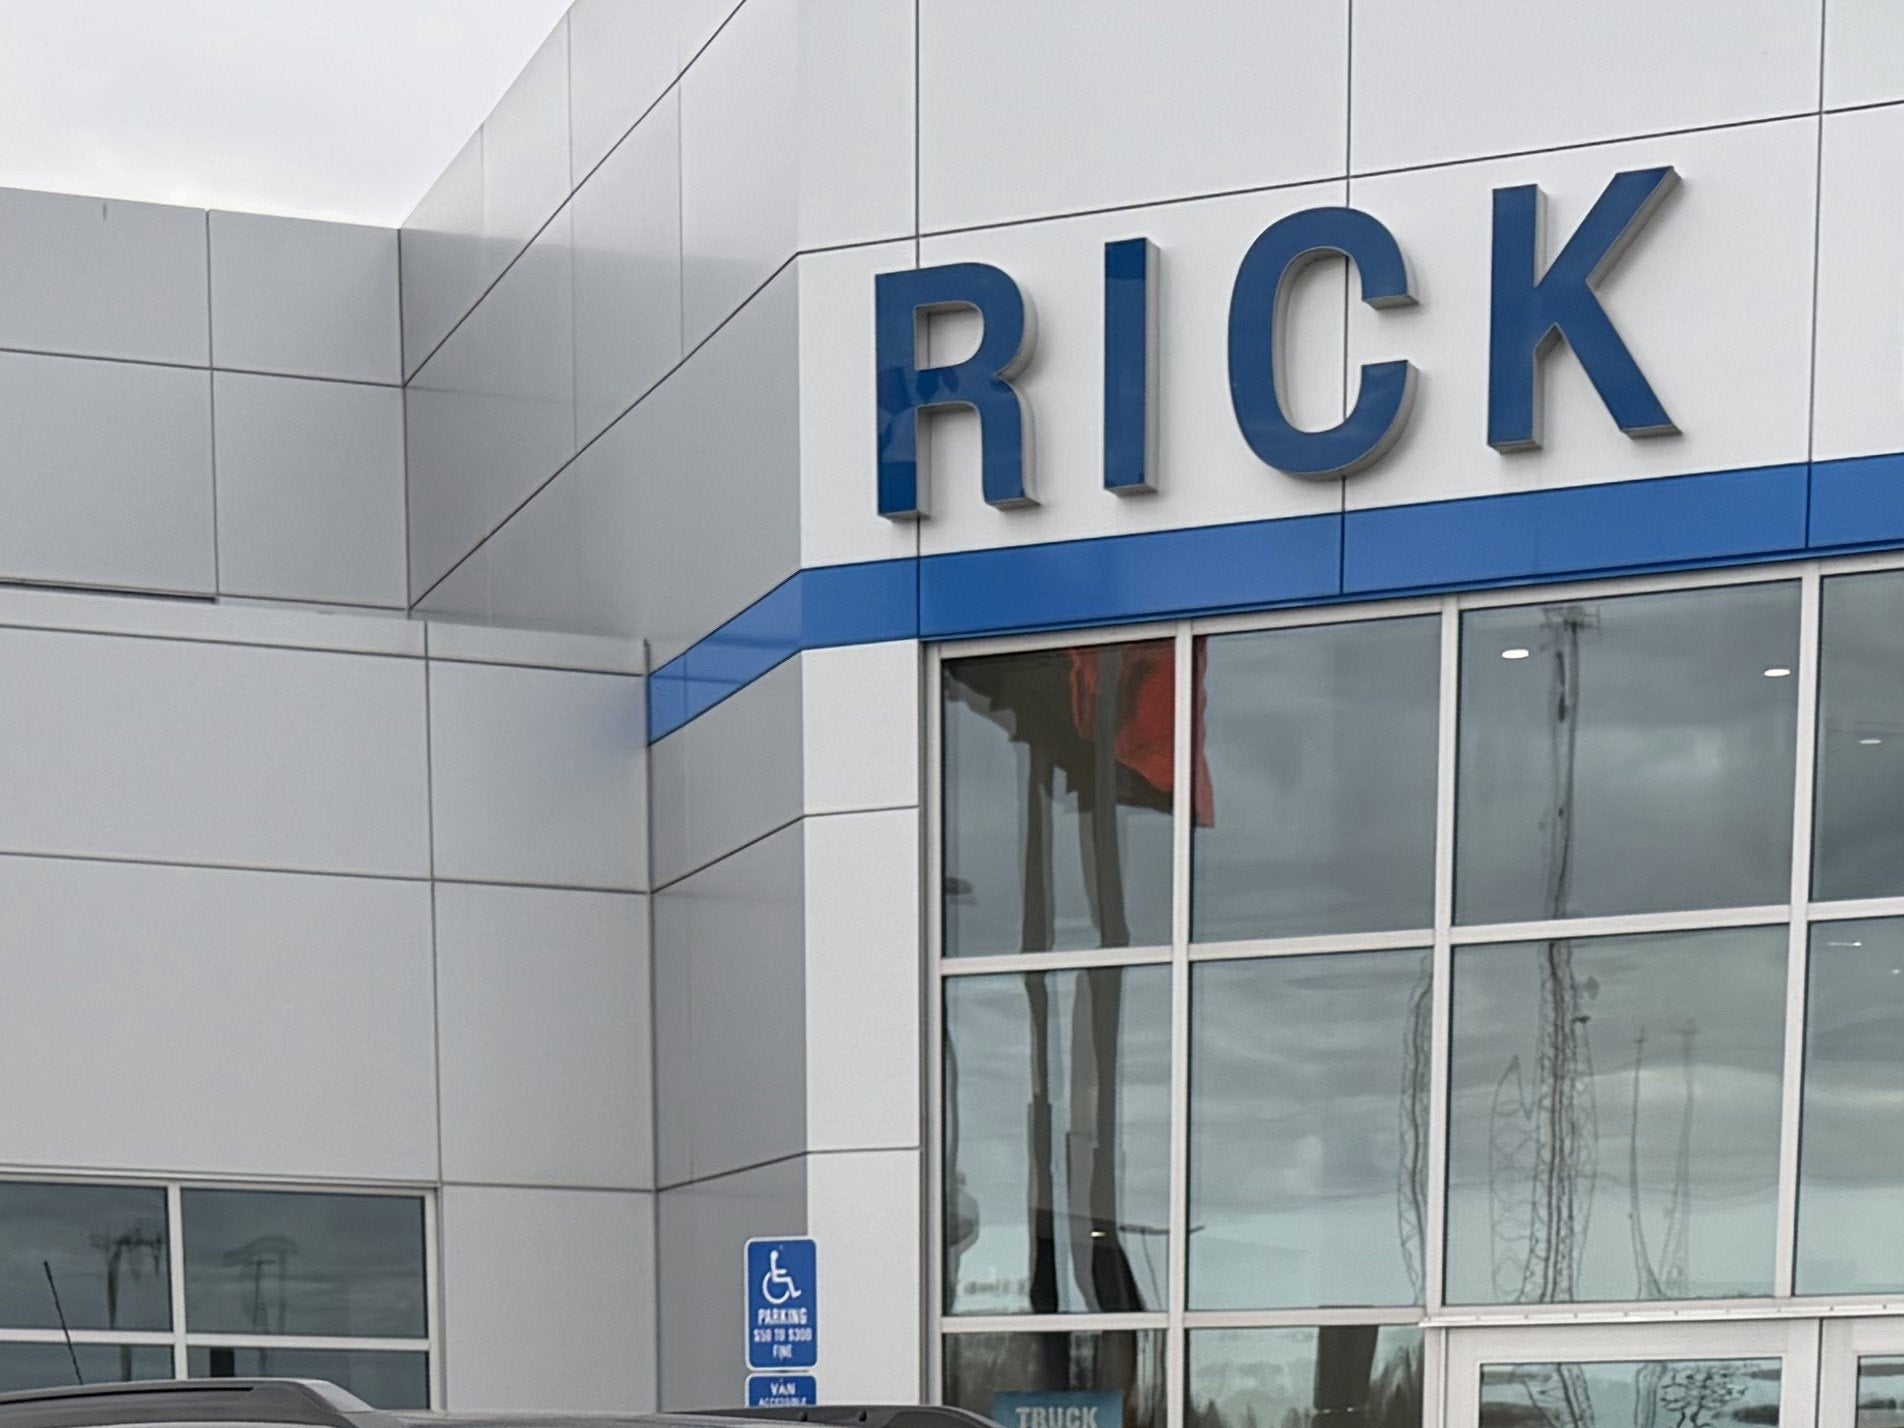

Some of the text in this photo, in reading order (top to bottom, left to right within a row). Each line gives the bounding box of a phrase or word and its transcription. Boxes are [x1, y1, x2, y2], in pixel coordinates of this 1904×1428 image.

[874, 165, 1682, 521] RICK
[757, 1307, 808, 1326] PARKING
[770, 1382, 796, 1396] VAN
